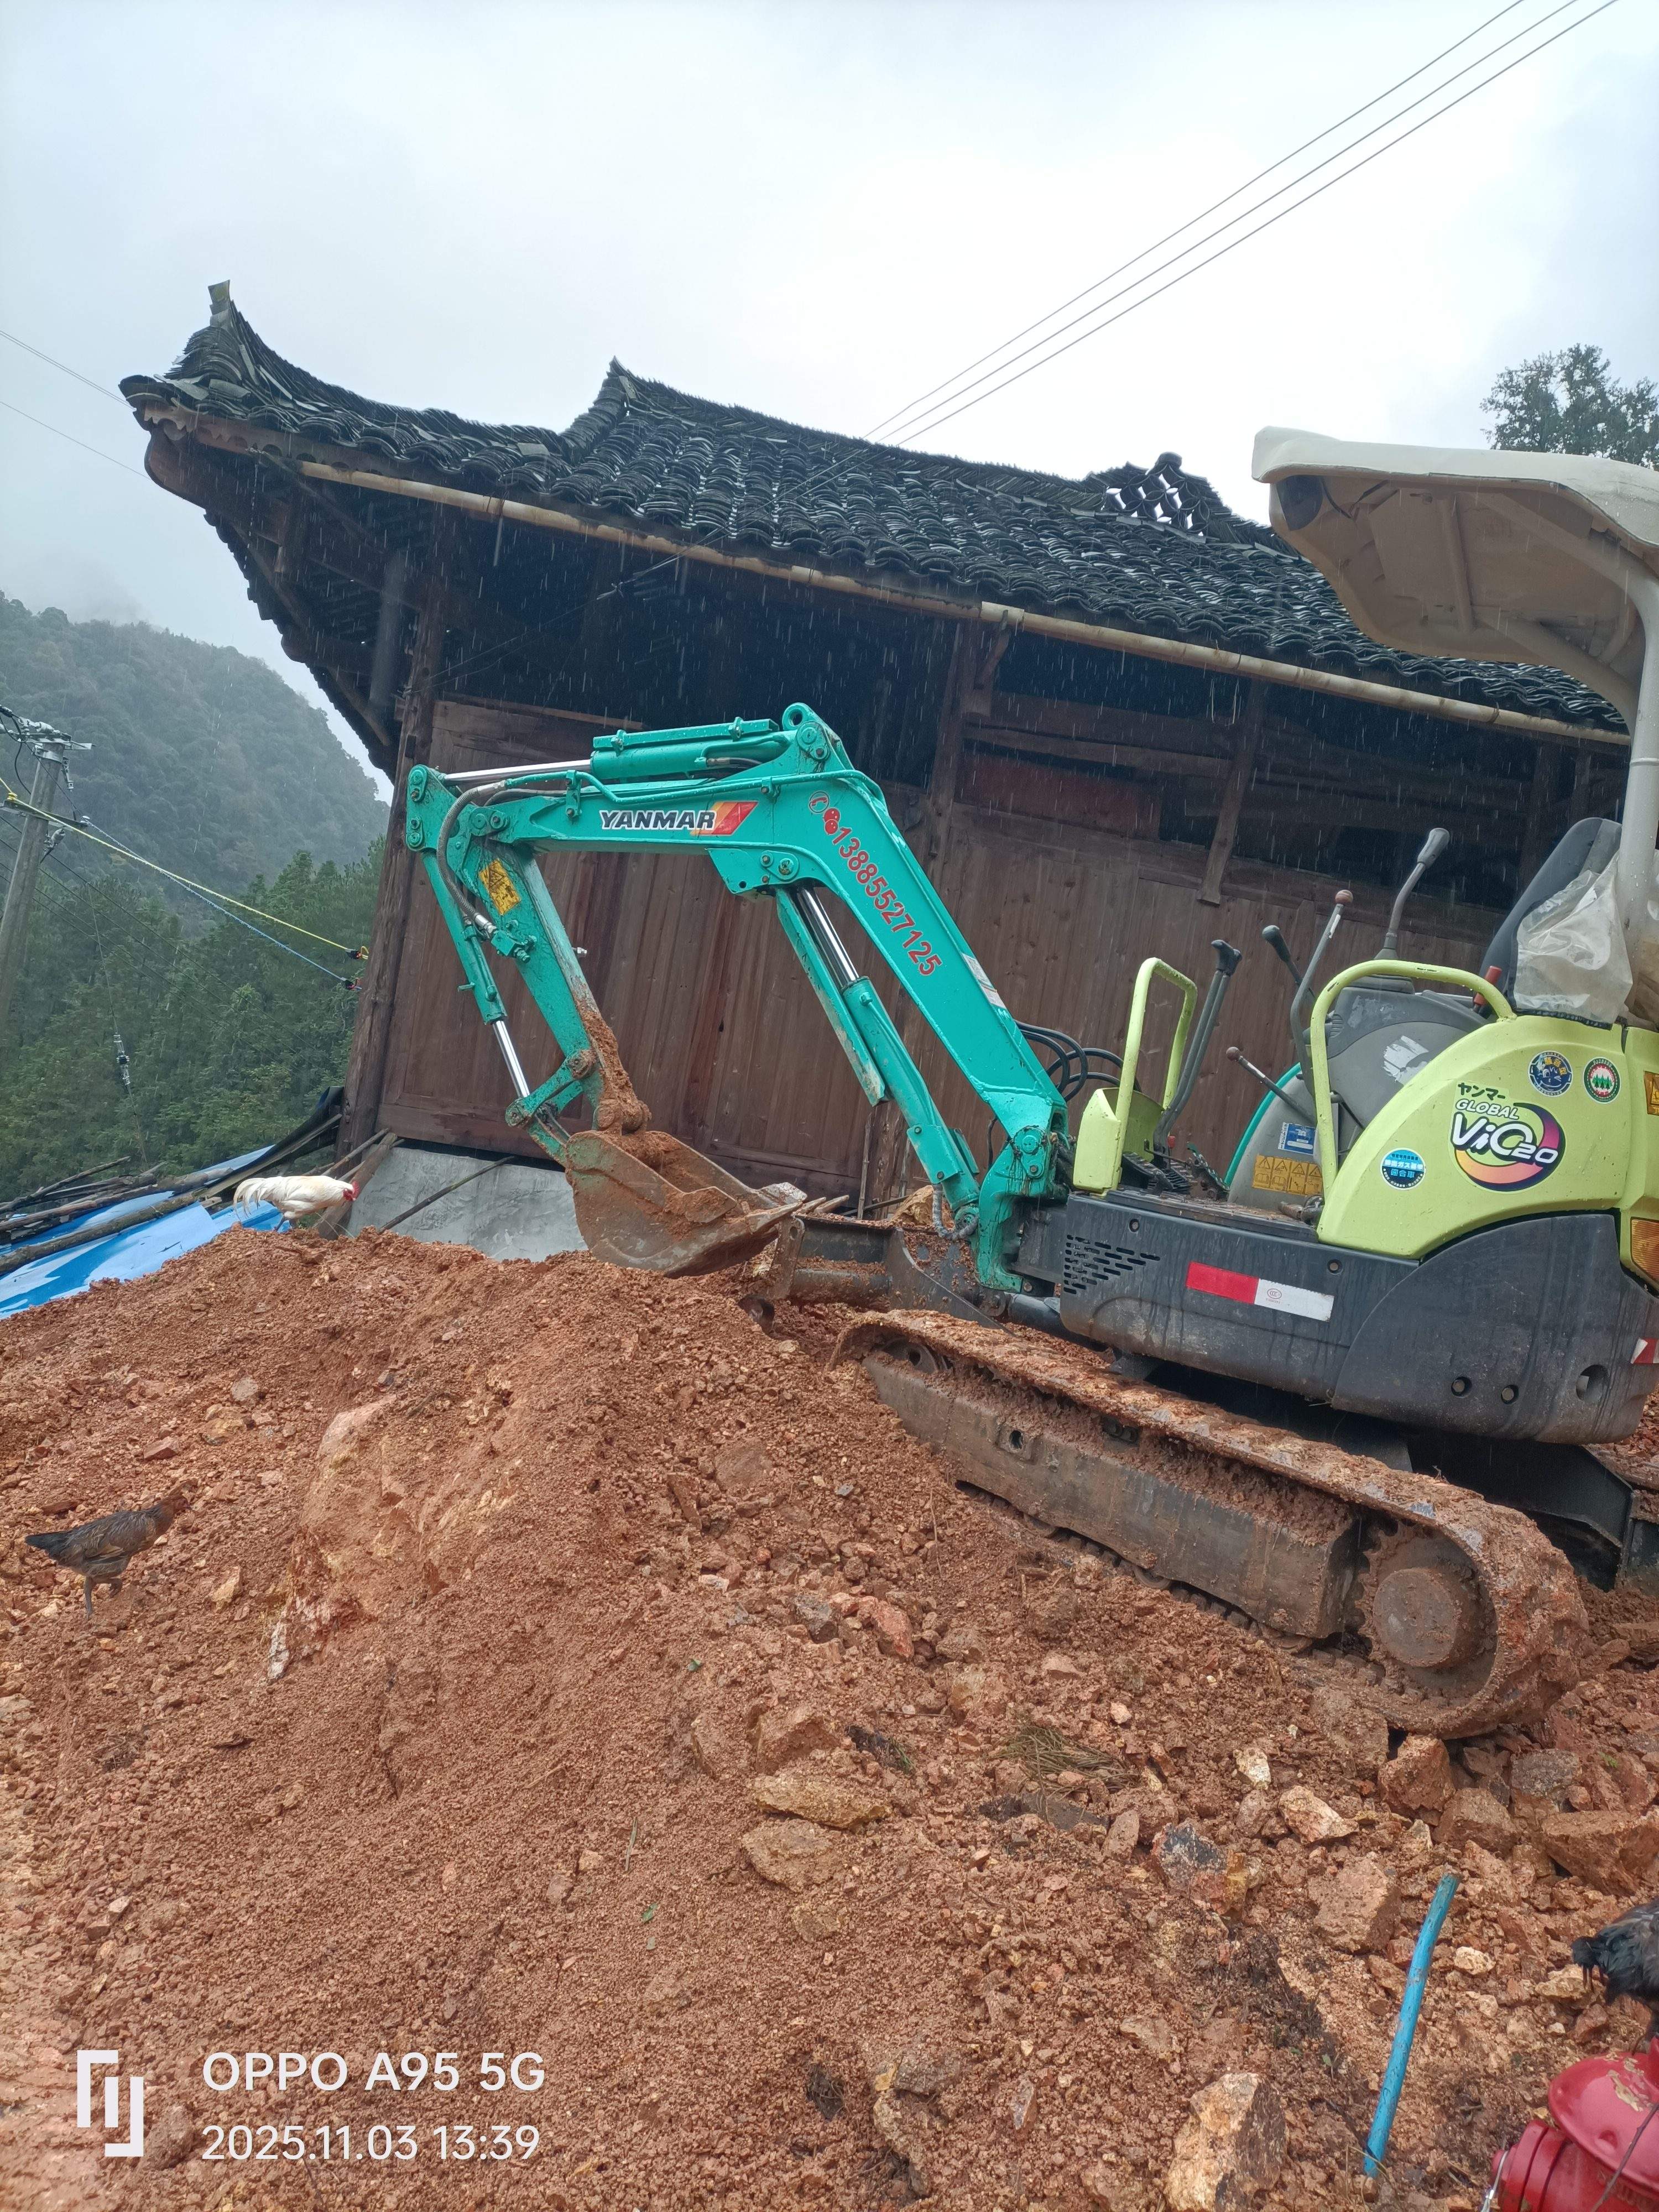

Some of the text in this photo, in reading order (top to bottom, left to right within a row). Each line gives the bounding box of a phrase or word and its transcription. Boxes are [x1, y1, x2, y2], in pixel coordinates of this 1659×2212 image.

[599, 810, 717, 831] YANMAR
[832, 827, 942, 975] 13885527125
[1458, 1082, 1506, 1100] ヤンマー
[1455, 1099, 1519, 1120] GLOBAL
